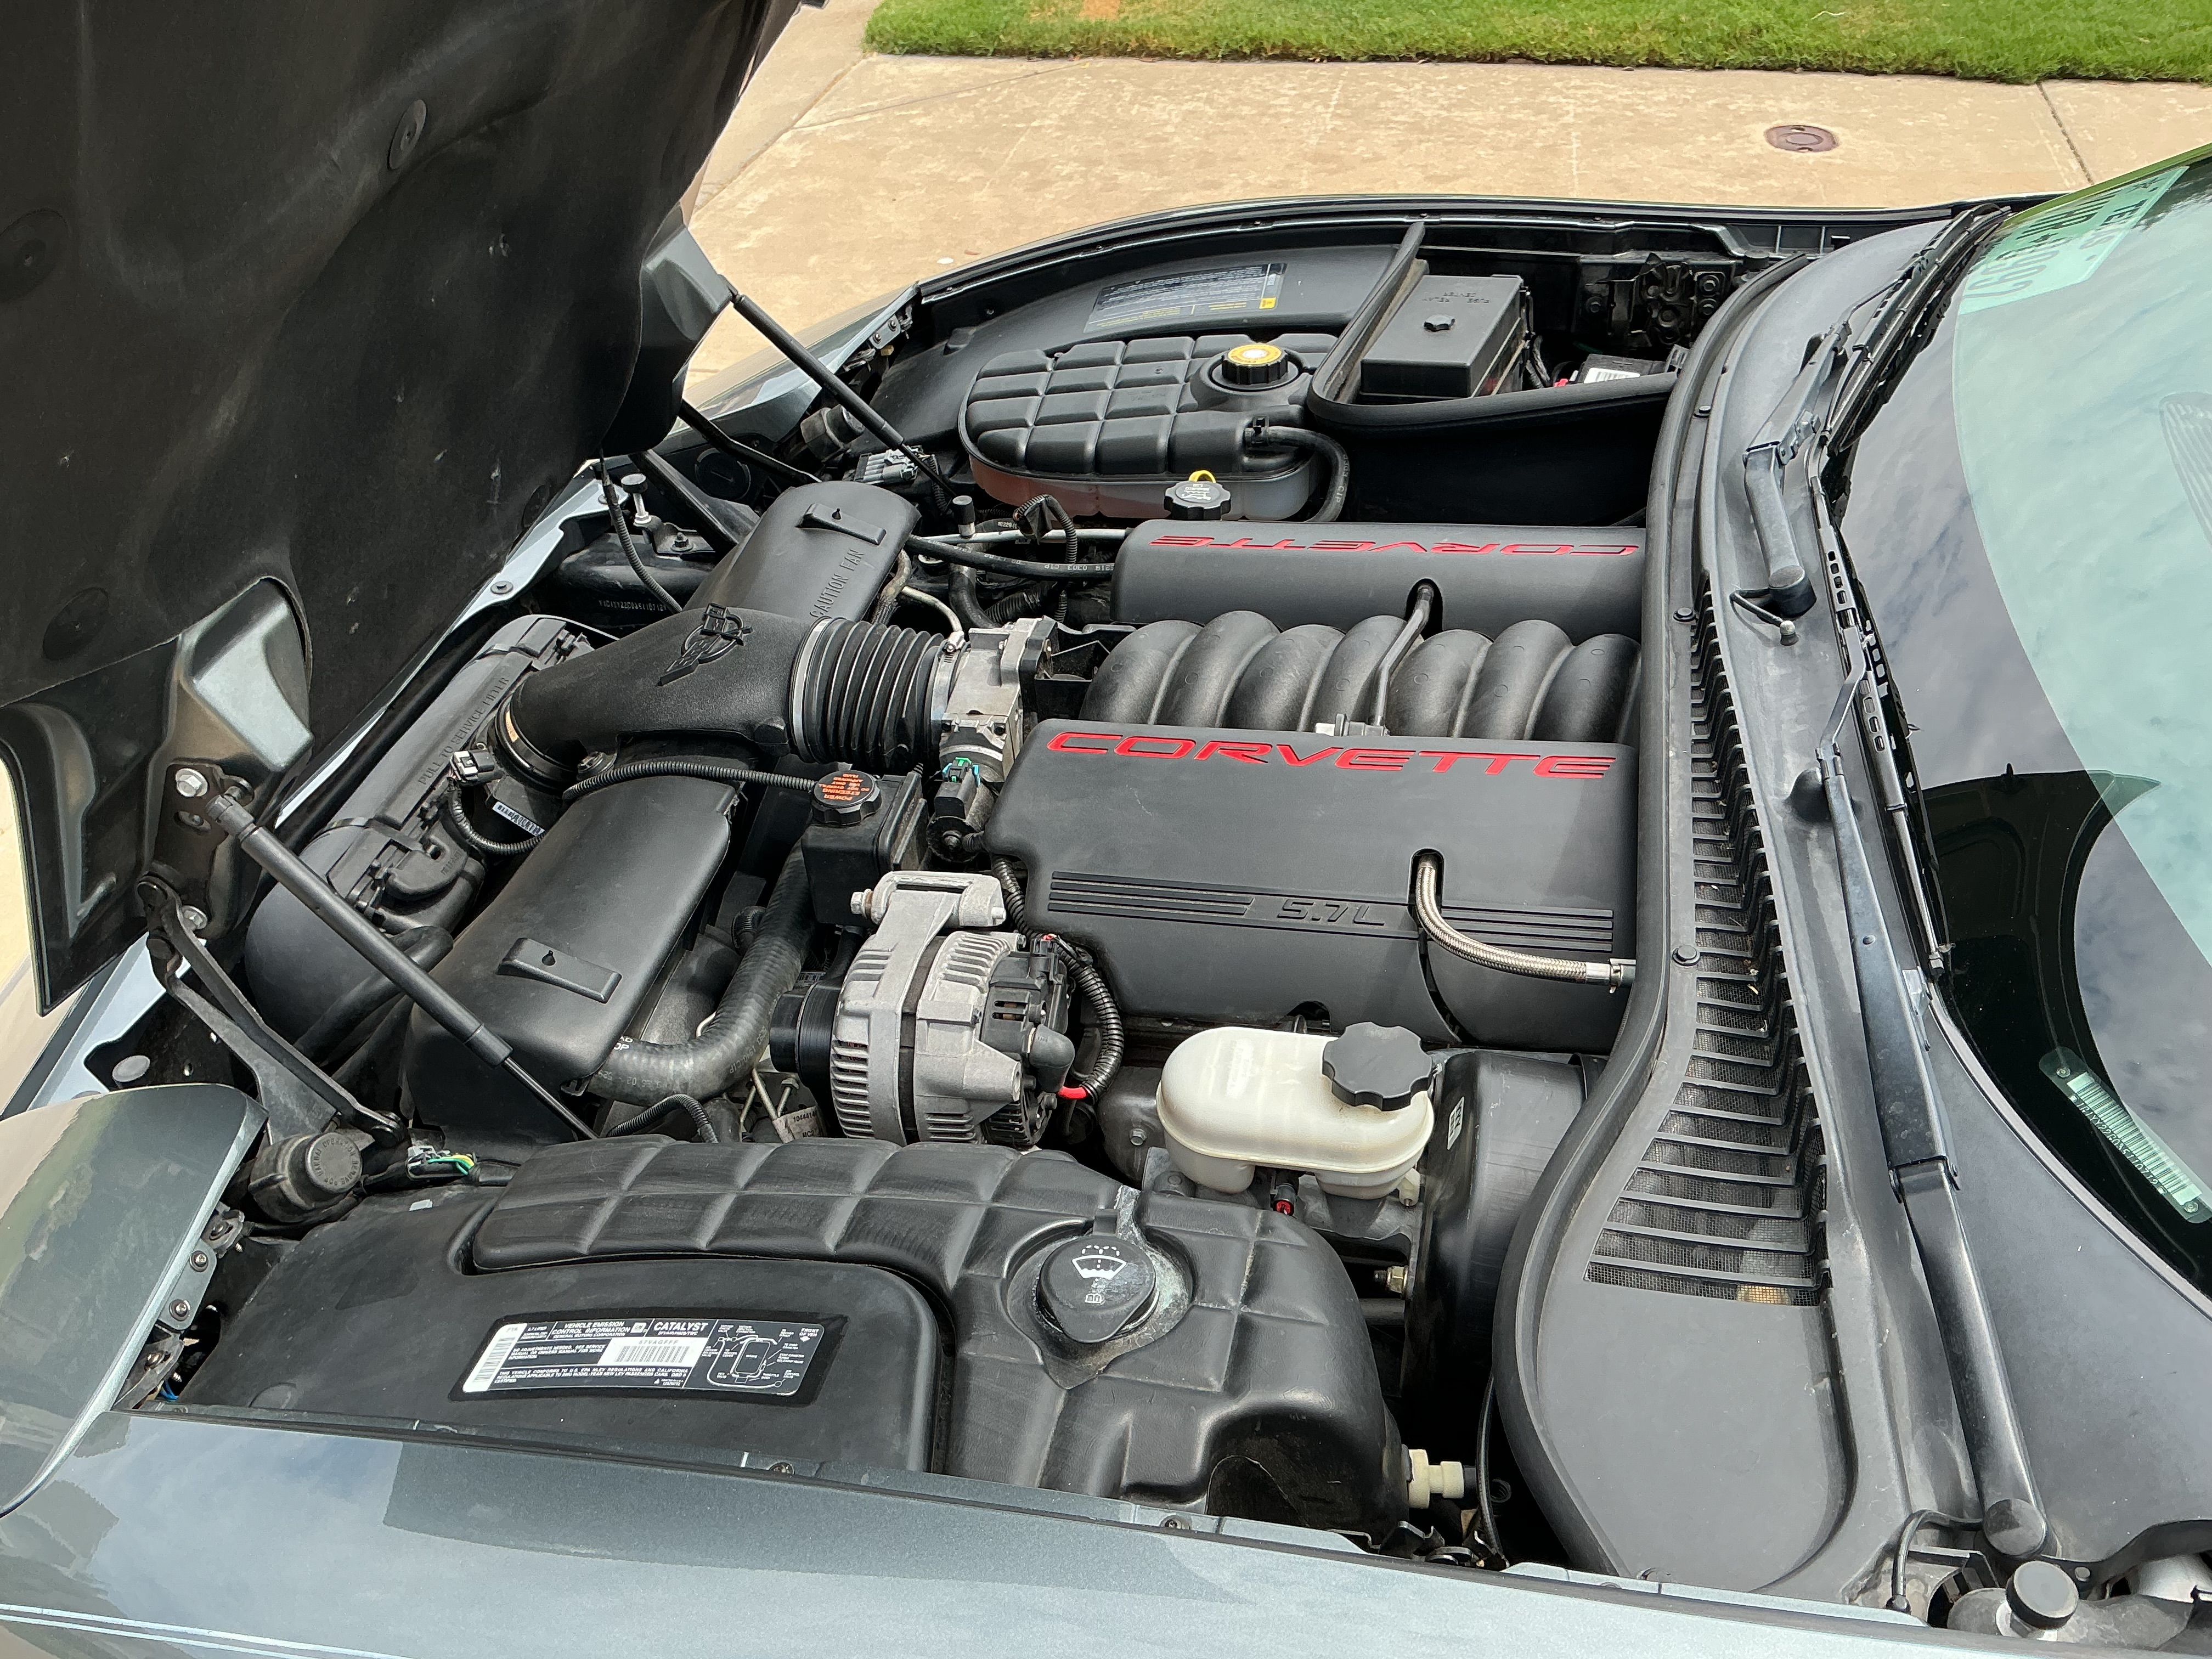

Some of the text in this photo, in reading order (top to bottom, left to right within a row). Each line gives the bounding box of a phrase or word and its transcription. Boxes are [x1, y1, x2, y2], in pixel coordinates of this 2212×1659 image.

[1147, 535, 1640, 556] CORVETTE
[809, 549, 865, 619] CAUTION FAN
[418, 757, 443, 786] PULL
[442, 745, 455, 760] TO
[450, 705, 486, 747] SERVICE
[1047, 731, 1616, 778] CORVETTE
[822, 788, 861, 796] STEERING
[1277, 898, 1385, 926] 5.7L
[653, 1322, 709, 1331] CATALYST
